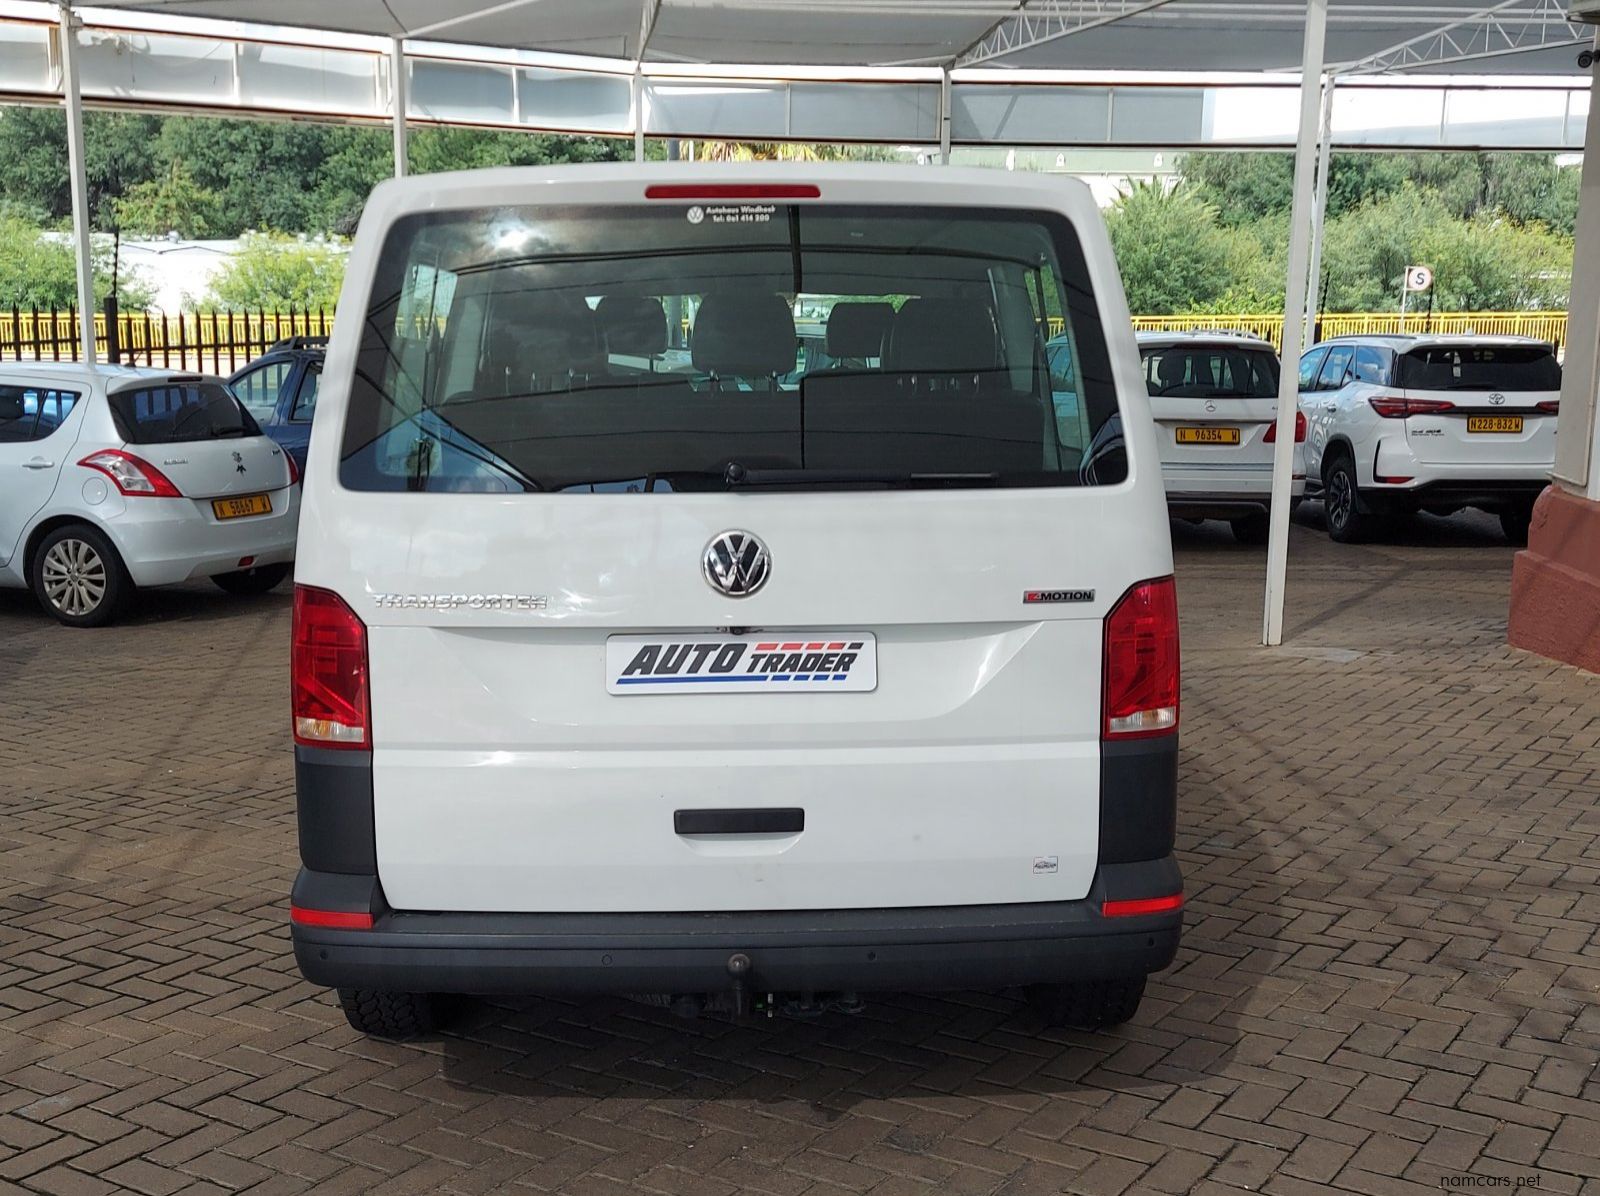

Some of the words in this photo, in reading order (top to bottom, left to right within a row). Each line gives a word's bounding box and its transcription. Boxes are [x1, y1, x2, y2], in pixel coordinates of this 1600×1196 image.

[706, 206, 739, 214] Autohaus
[740, 205, 776, 213] Windhoek
[741, 214, 753, 222] 414
[1415, 272, 1425, 285] S
[1195, 430, 1222, 440] 96354
[373, 593, 548, 610] TRANSPORTER
[621, 643, 748, 676] AUTO
[746, 652, 858, 673] TRADER
